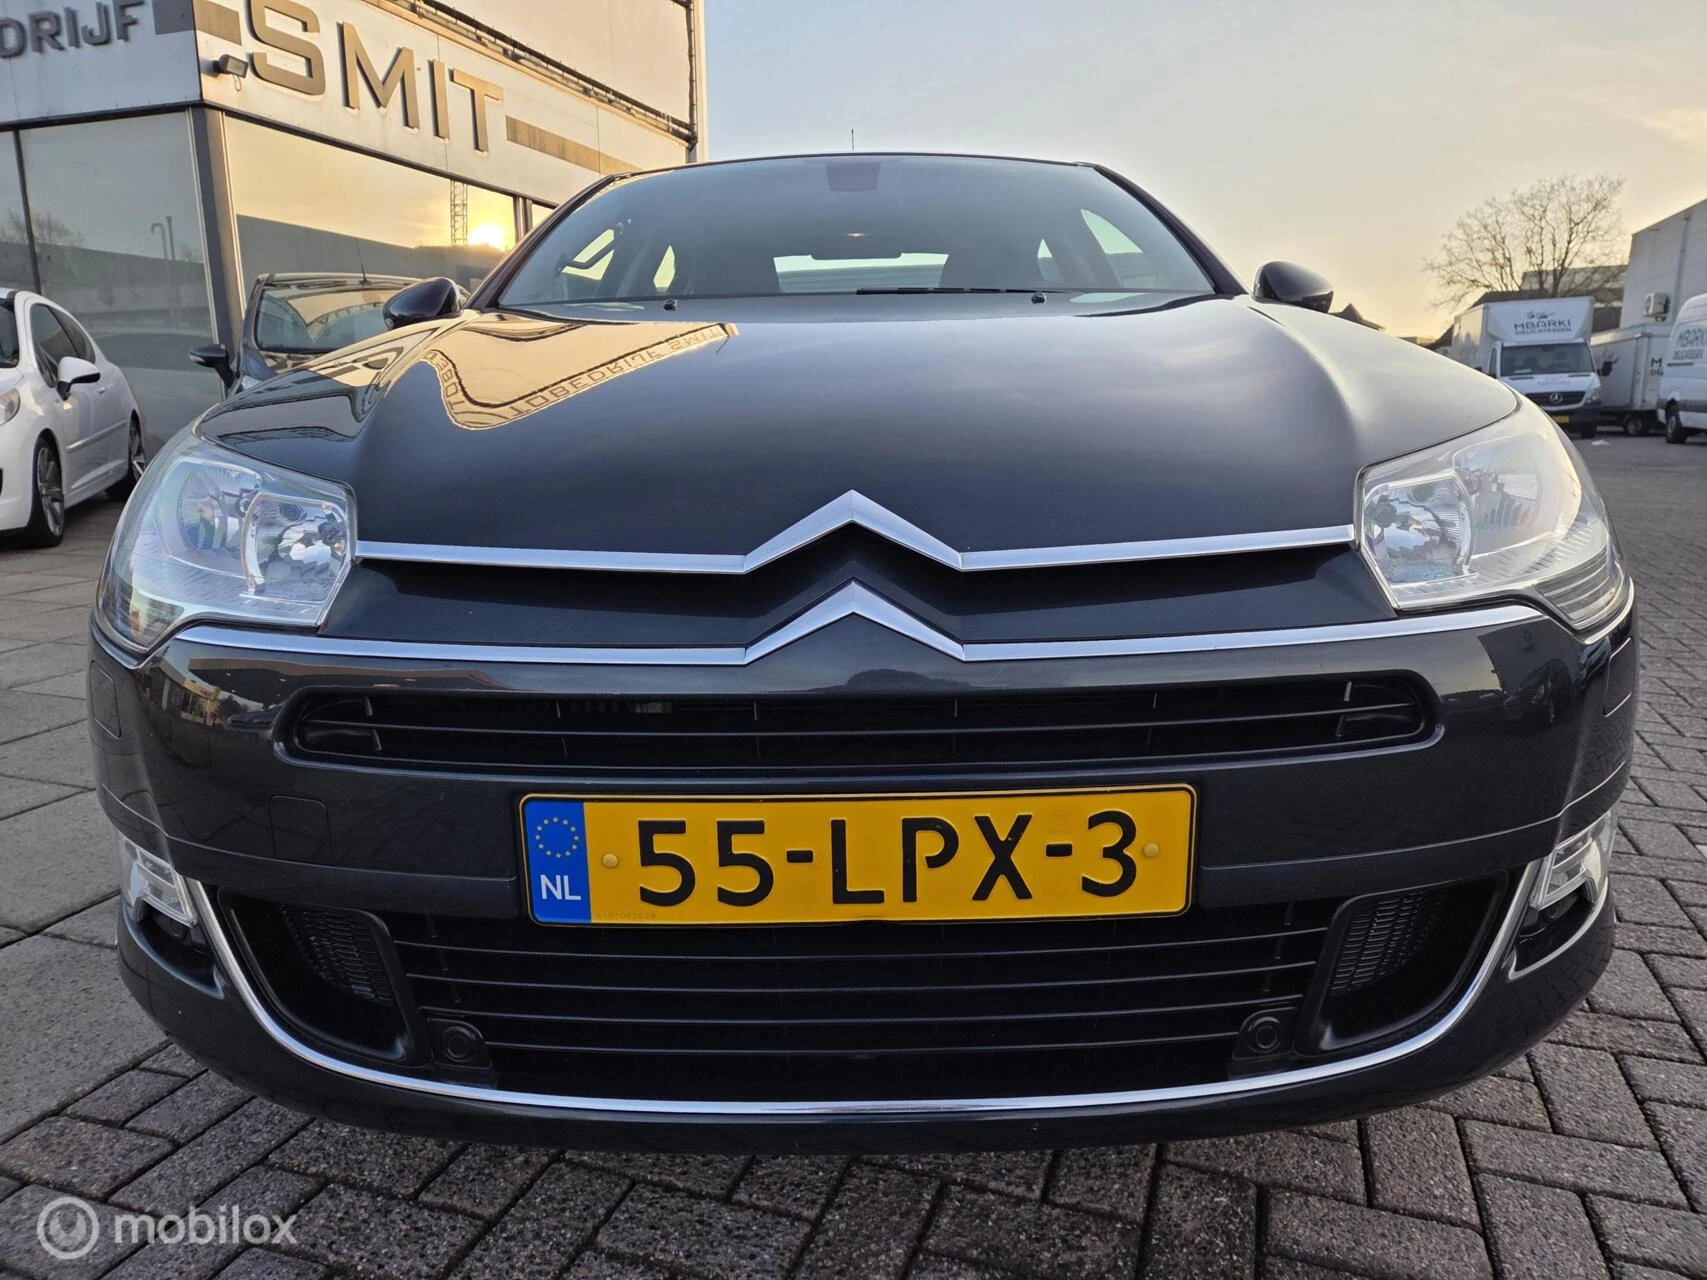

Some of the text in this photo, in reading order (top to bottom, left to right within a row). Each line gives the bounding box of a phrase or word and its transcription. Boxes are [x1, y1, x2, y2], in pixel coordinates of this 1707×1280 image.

[248, 0, 501, 153] SMIT
[541, 810, 1137, 907] NL 55-LPX-3
